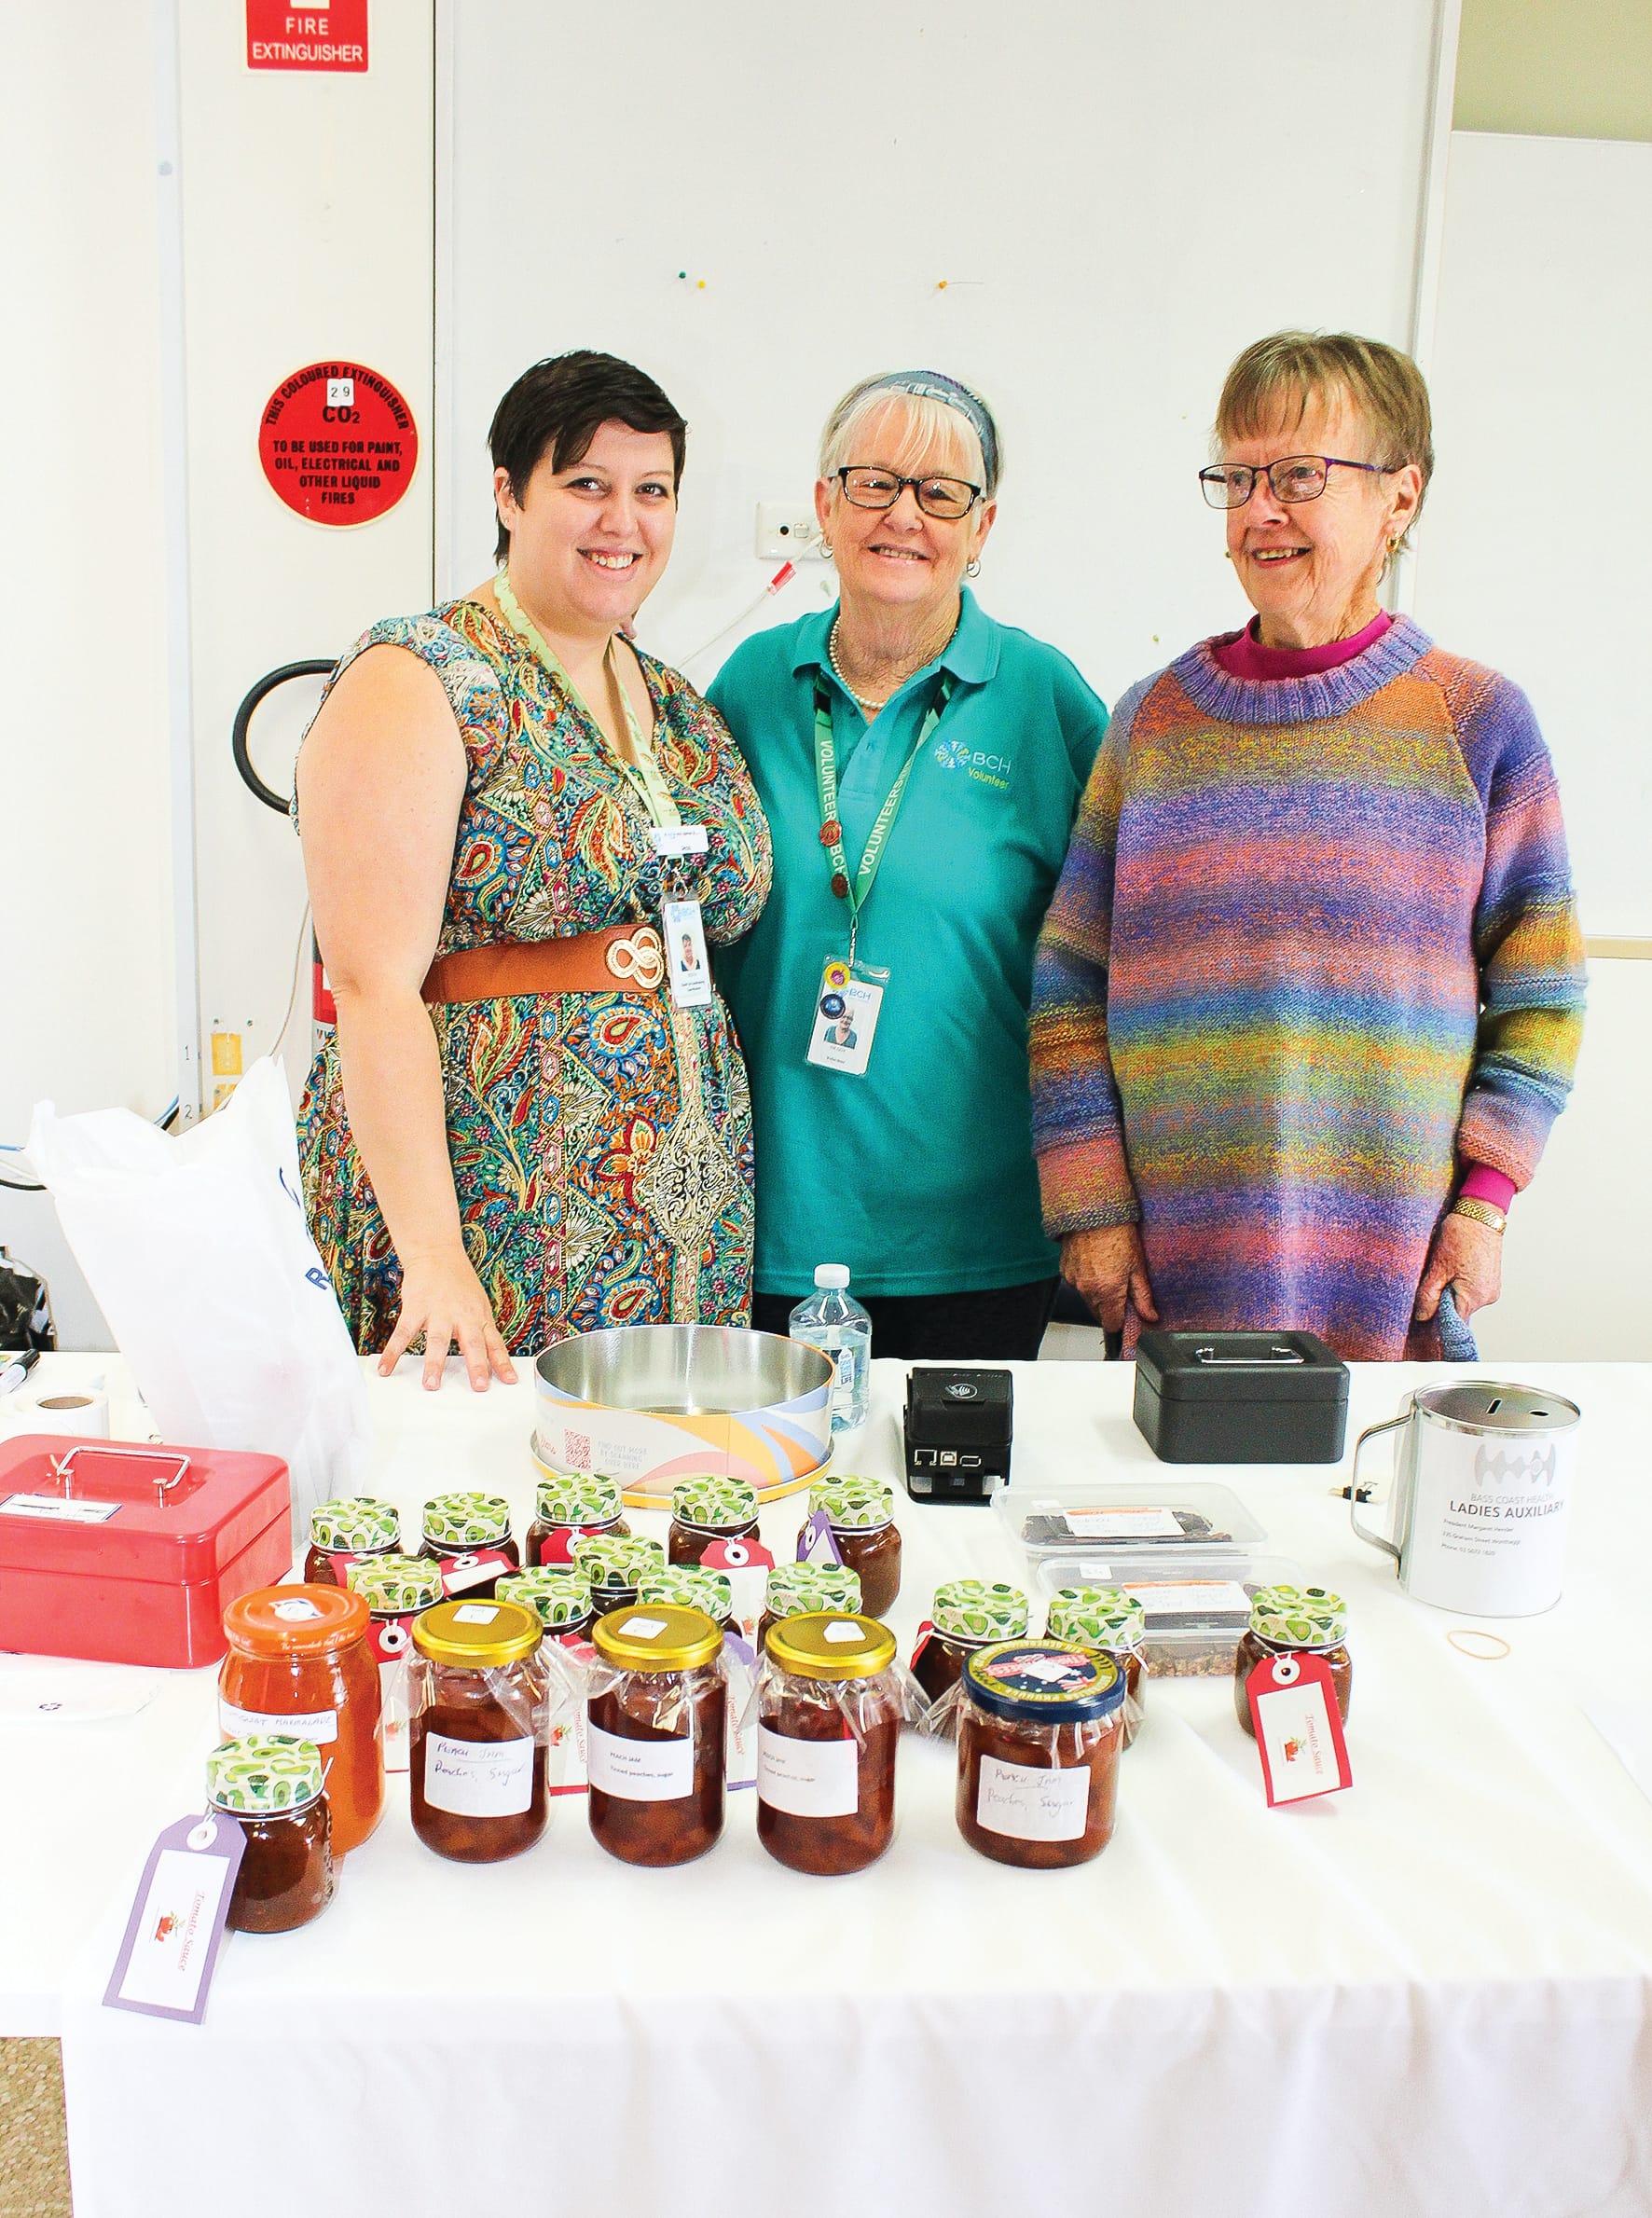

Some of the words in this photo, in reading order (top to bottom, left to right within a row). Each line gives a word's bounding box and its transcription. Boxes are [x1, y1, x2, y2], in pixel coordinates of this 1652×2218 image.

[285, 17, 329, 35] FIRE
[252, 41, 364, 62] EXTINGUISHER
[265, 398, 285, 425] THIS
[282, 365, 339, 399] COLOURED
[343, 365, 410, 430] EXTINGUISHER
[273, 440, 287, 452] TO
[291, 441, 305, 453] BE
[309, 441, 339, 453] USED
[342, 441, 365, 453] FOR
[367, 442, 403, 456] PAINT,
[275, 458, 298, 472] OIL,
[301, 458, 372, 471] ELECTRICAL
[377, 460, 400, 472] AND
[299, 475, 337, 488] OTHER
[341, 475, 381, 490] LIQUID
[321, 491, 355, 504] FIRES
[972, 752, 1012, 774] BCH
[968, 766, 1011, 791] Volunteer
[859, 778, 903, 875] VOLUNTEERS
[848, 987, 872, 1000] BCH
[1450, 1500, 1500, 1518] LADIES
[1505, 1499, 1564, 1519] AUXILIARY
[1470, 1493, 1494, 1505] BASS
[1495, 1495, 1525, 1506] COAST
[188, 1892, 205, 1936] Tomato
[178, 1938, 194, 1972] Sauce
